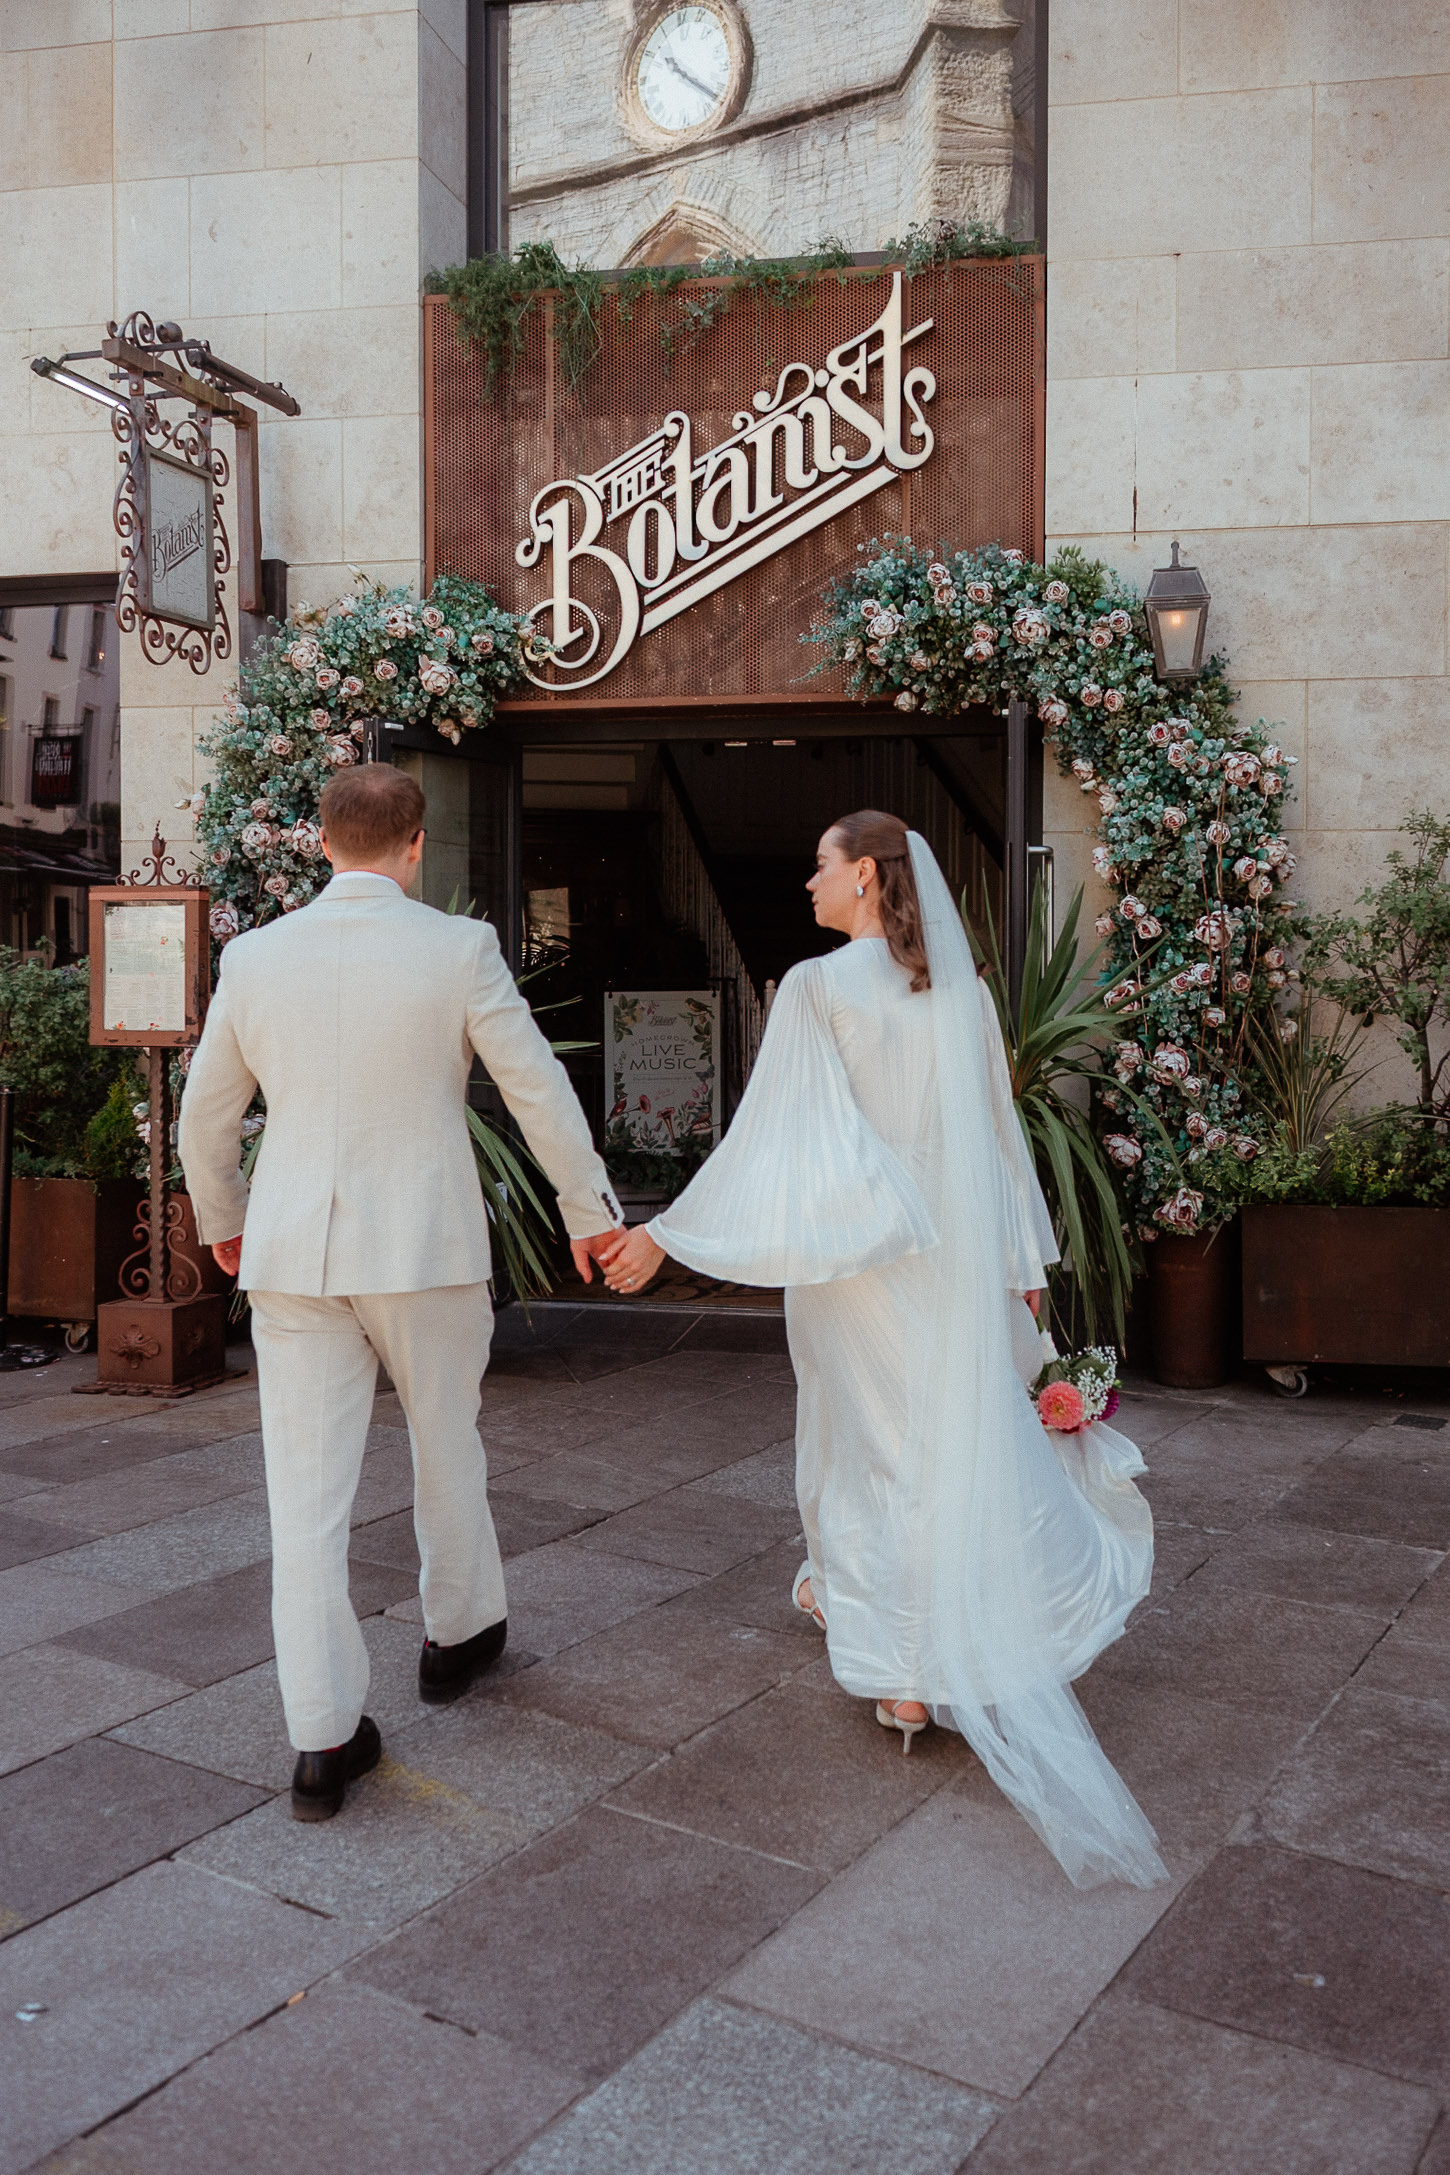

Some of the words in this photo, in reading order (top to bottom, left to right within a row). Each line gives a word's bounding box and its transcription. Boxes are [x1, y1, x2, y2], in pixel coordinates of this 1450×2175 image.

[515, 271, 936, 692] Botanist
[600, 445, 667, 521] THE
[152, 500, 204, 583] Botanist
[629, 1058, 697, 1071] MUSIC
[641, 1044, 686, 1056] LIVE
